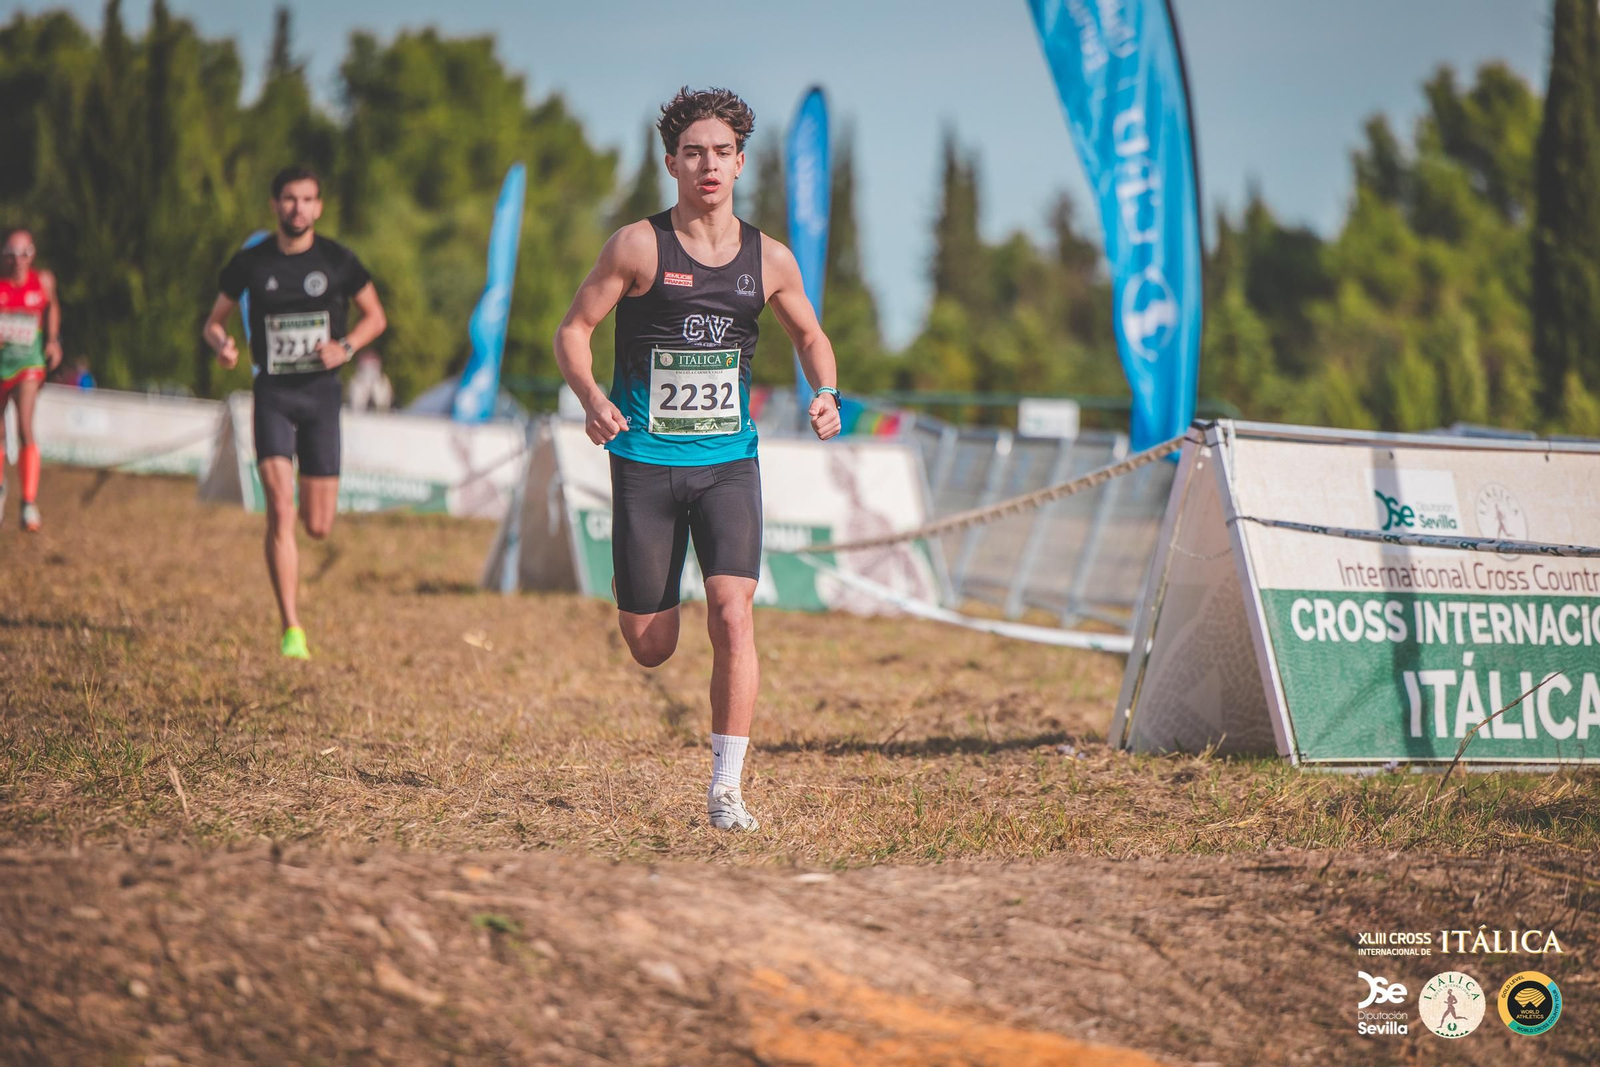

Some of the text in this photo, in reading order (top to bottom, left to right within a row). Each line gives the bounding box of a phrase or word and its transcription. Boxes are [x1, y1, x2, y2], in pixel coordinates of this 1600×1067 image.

[683, 314, 734, 344] CV
[679, 354, 721, 365] ITÁLICA
[660, 382, 734, 411] 2232
[1419, 514, 1457, 529] Sevilla
[1337, 560, 1471, 589] International
[1474, 562, 1530, 590] Cross
[1290, 598, 1408, 643] CROSS
[1403, 651, 1600, 740] ITÁLICA
